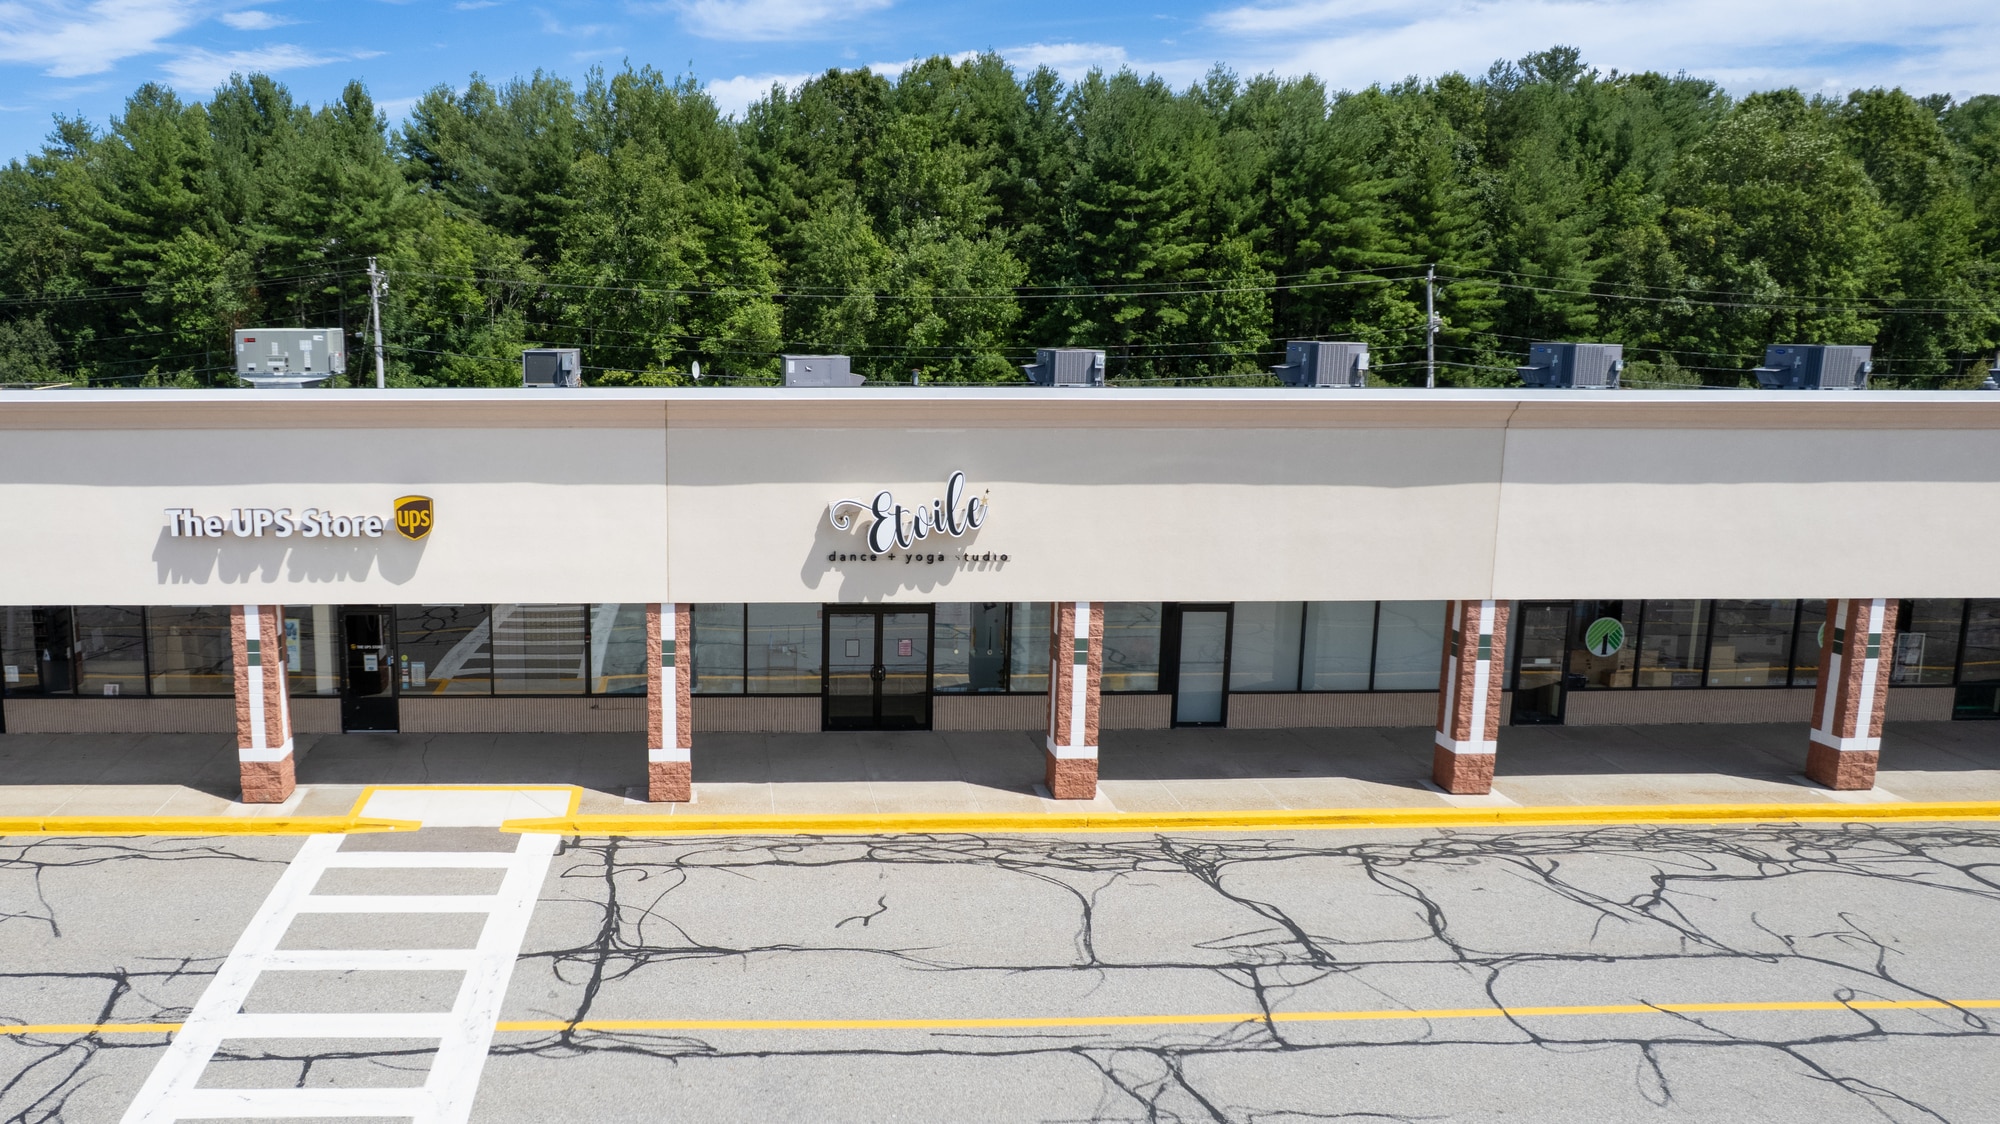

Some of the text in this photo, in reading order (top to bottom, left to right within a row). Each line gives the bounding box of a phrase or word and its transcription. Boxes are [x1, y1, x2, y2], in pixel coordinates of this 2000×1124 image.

[164, 508, 383, 538] The UPS Store
[397, 510, 430, 534] ups
[830, 470, 989, 554] Etoile
[828, 551, 877, 562] dance
[905, 553, 945, 564] yoga
